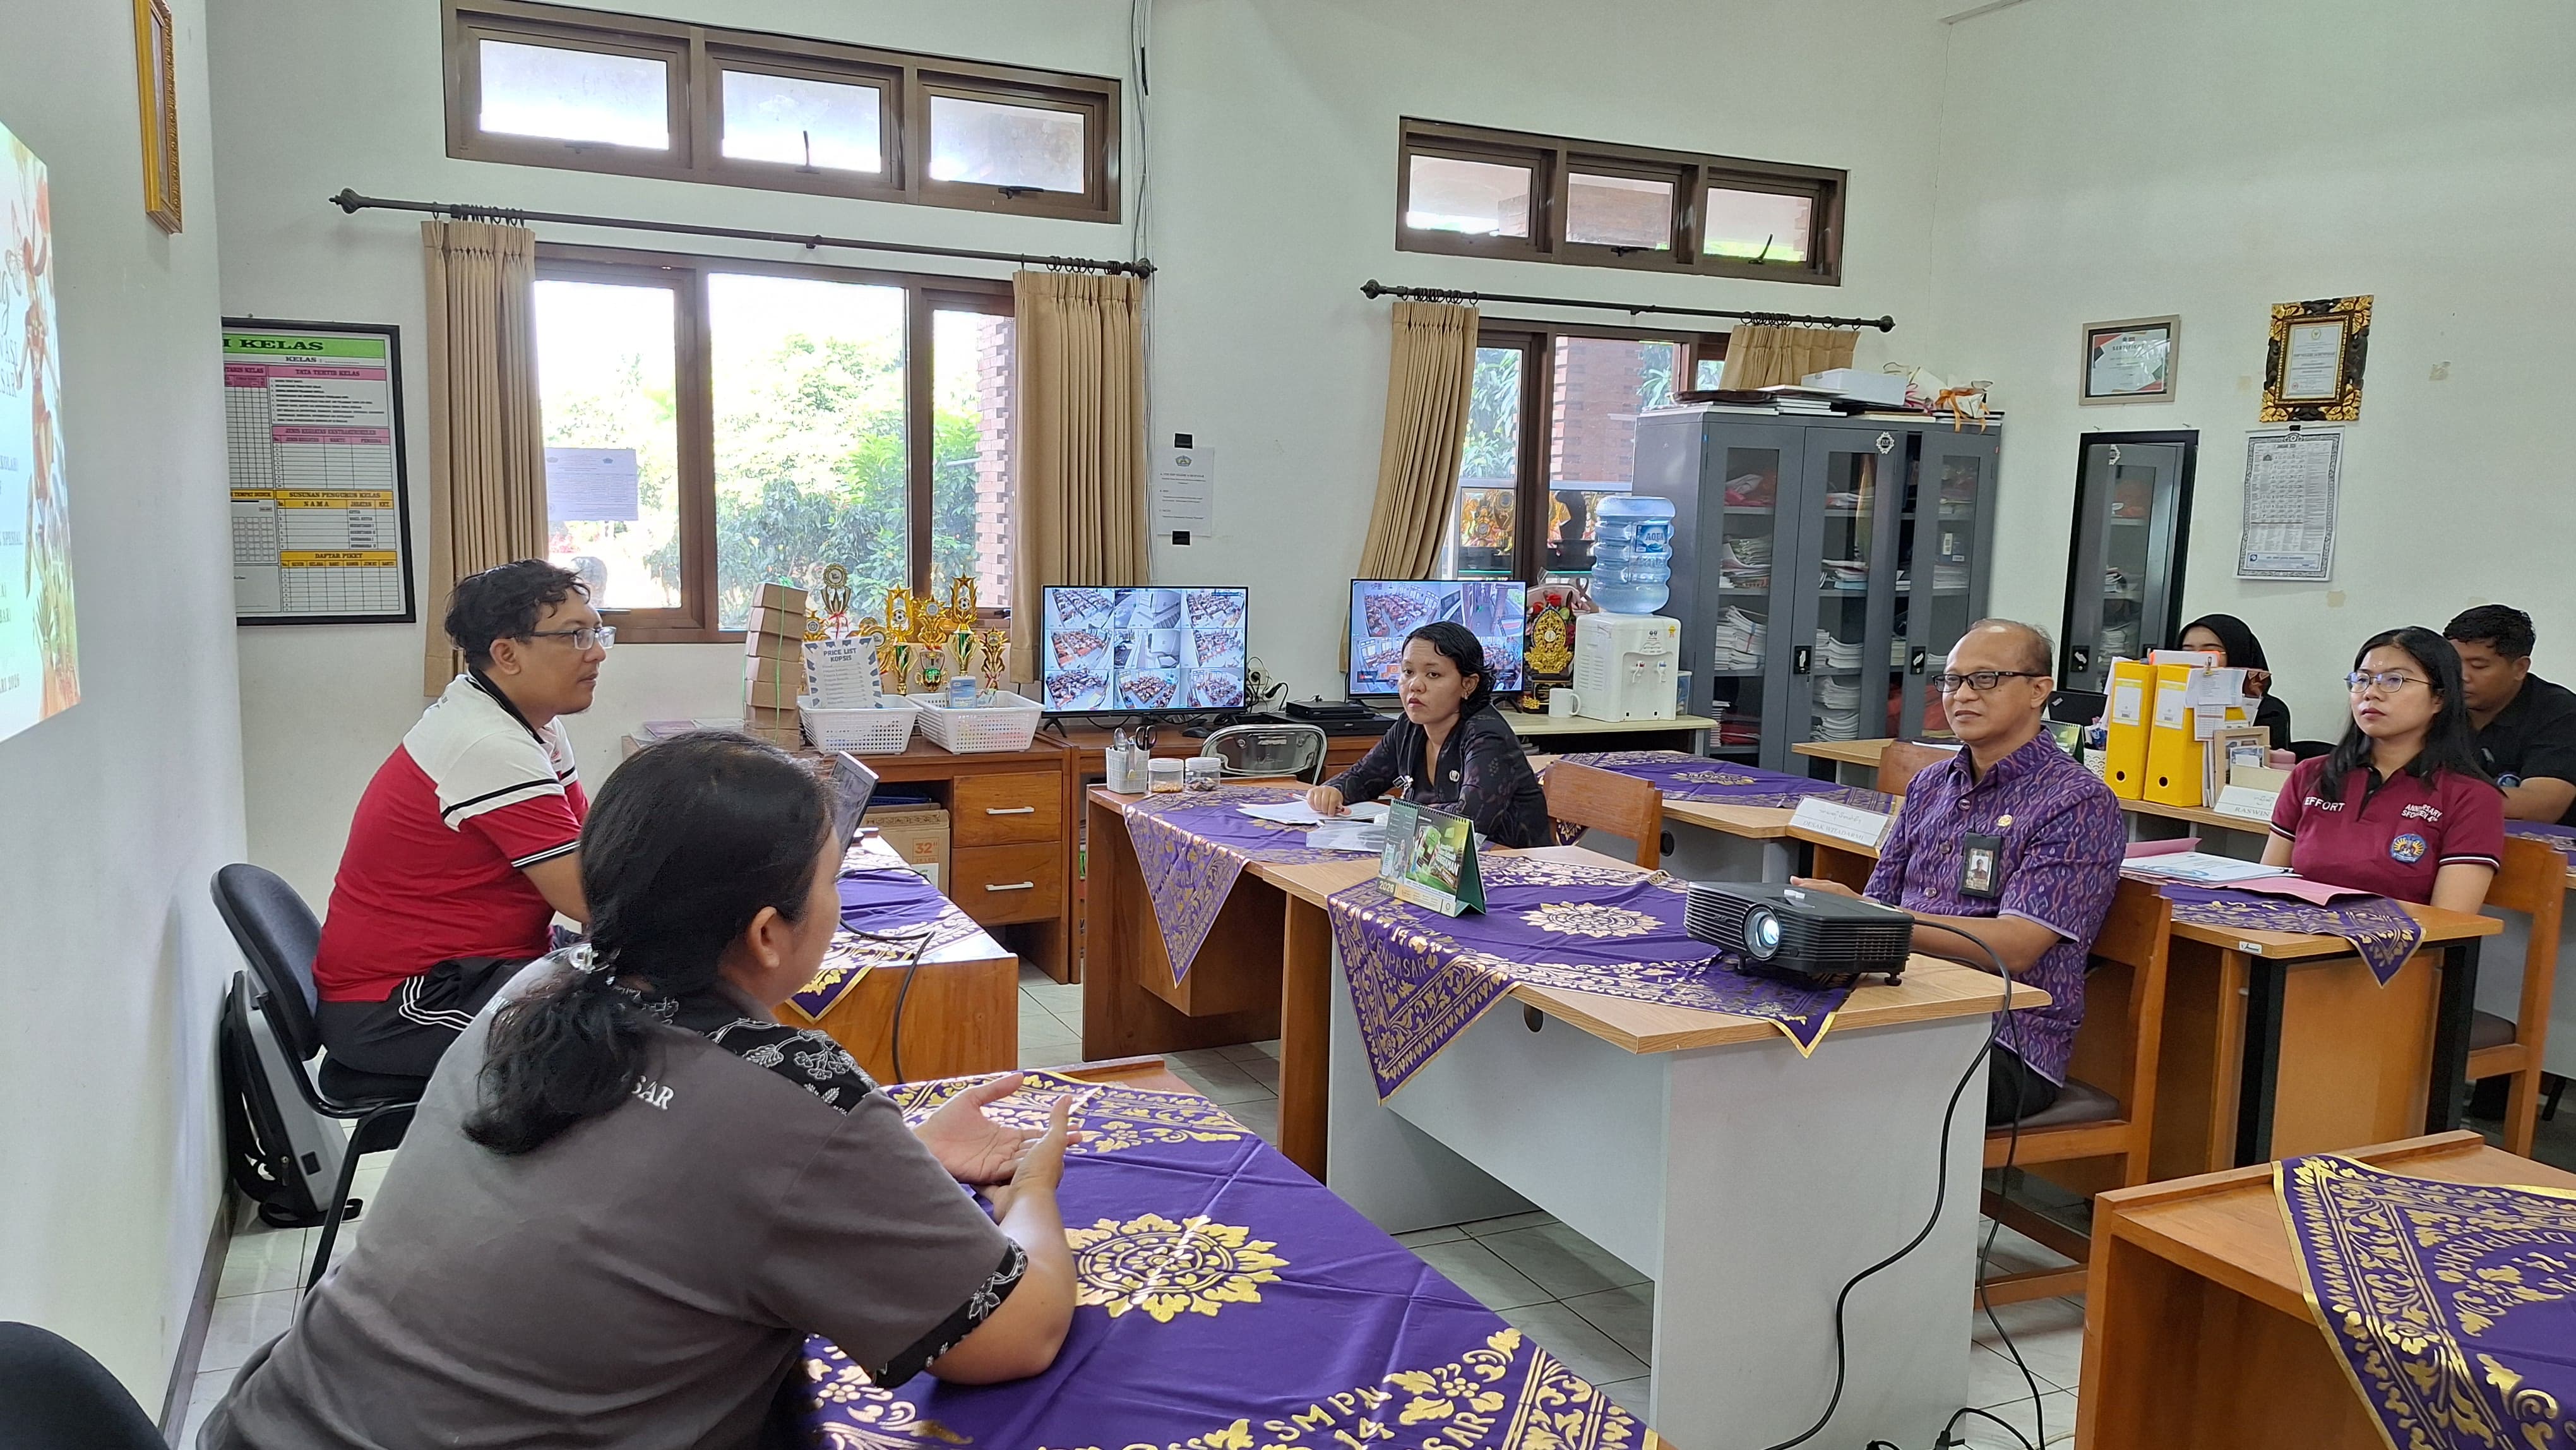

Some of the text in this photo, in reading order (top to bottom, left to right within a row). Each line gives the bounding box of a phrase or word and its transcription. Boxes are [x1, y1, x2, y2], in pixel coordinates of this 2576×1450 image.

[239, 339, 324, 351] KELAS
[1645, 532, 1664, 542] AQUA
[2304, 796, 2346, 812] EFFORT
[2235, 806, 2270, 817] RASWIN
[1803, 820, 1865, 840] DESAK WITADARMI
[1368, 928, 1428, 979] DENPASAR
